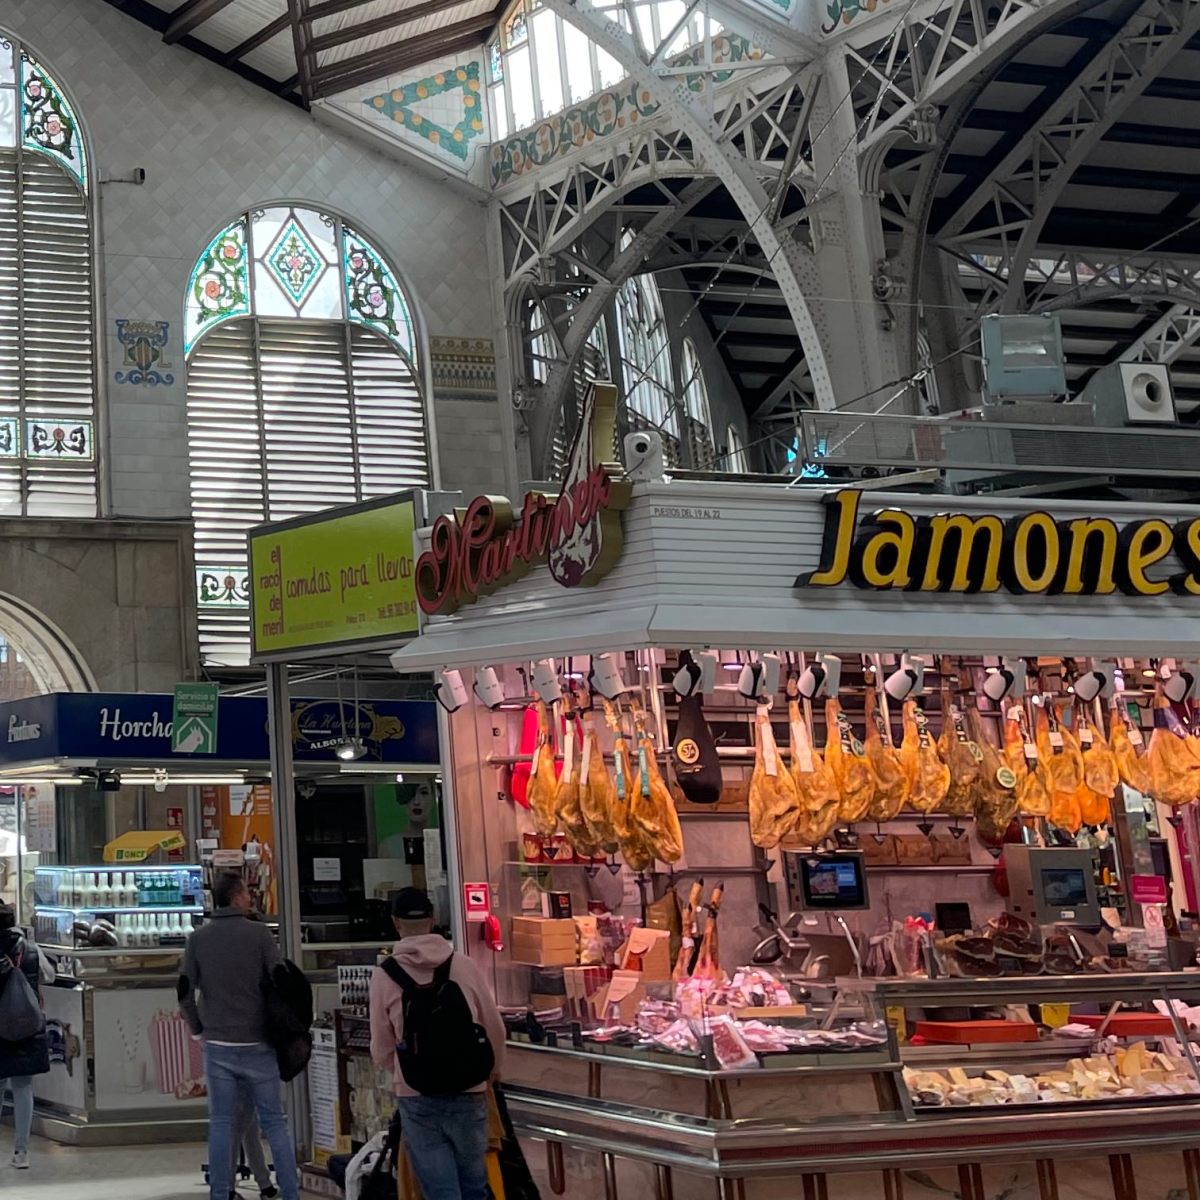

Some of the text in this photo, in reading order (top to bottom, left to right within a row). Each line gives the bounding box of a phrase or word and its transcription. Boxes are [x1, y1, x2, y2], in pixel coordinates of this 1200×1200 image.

[653, 507, 680, 519] PUESTOS
[681, 508, 693, 519] DEL
[703, 509, 712, 520] AL
[712, 510, 721, 520] 22
[287, 552, 414, 603] comidas para llevar
[269, 595, 281, 612] de
